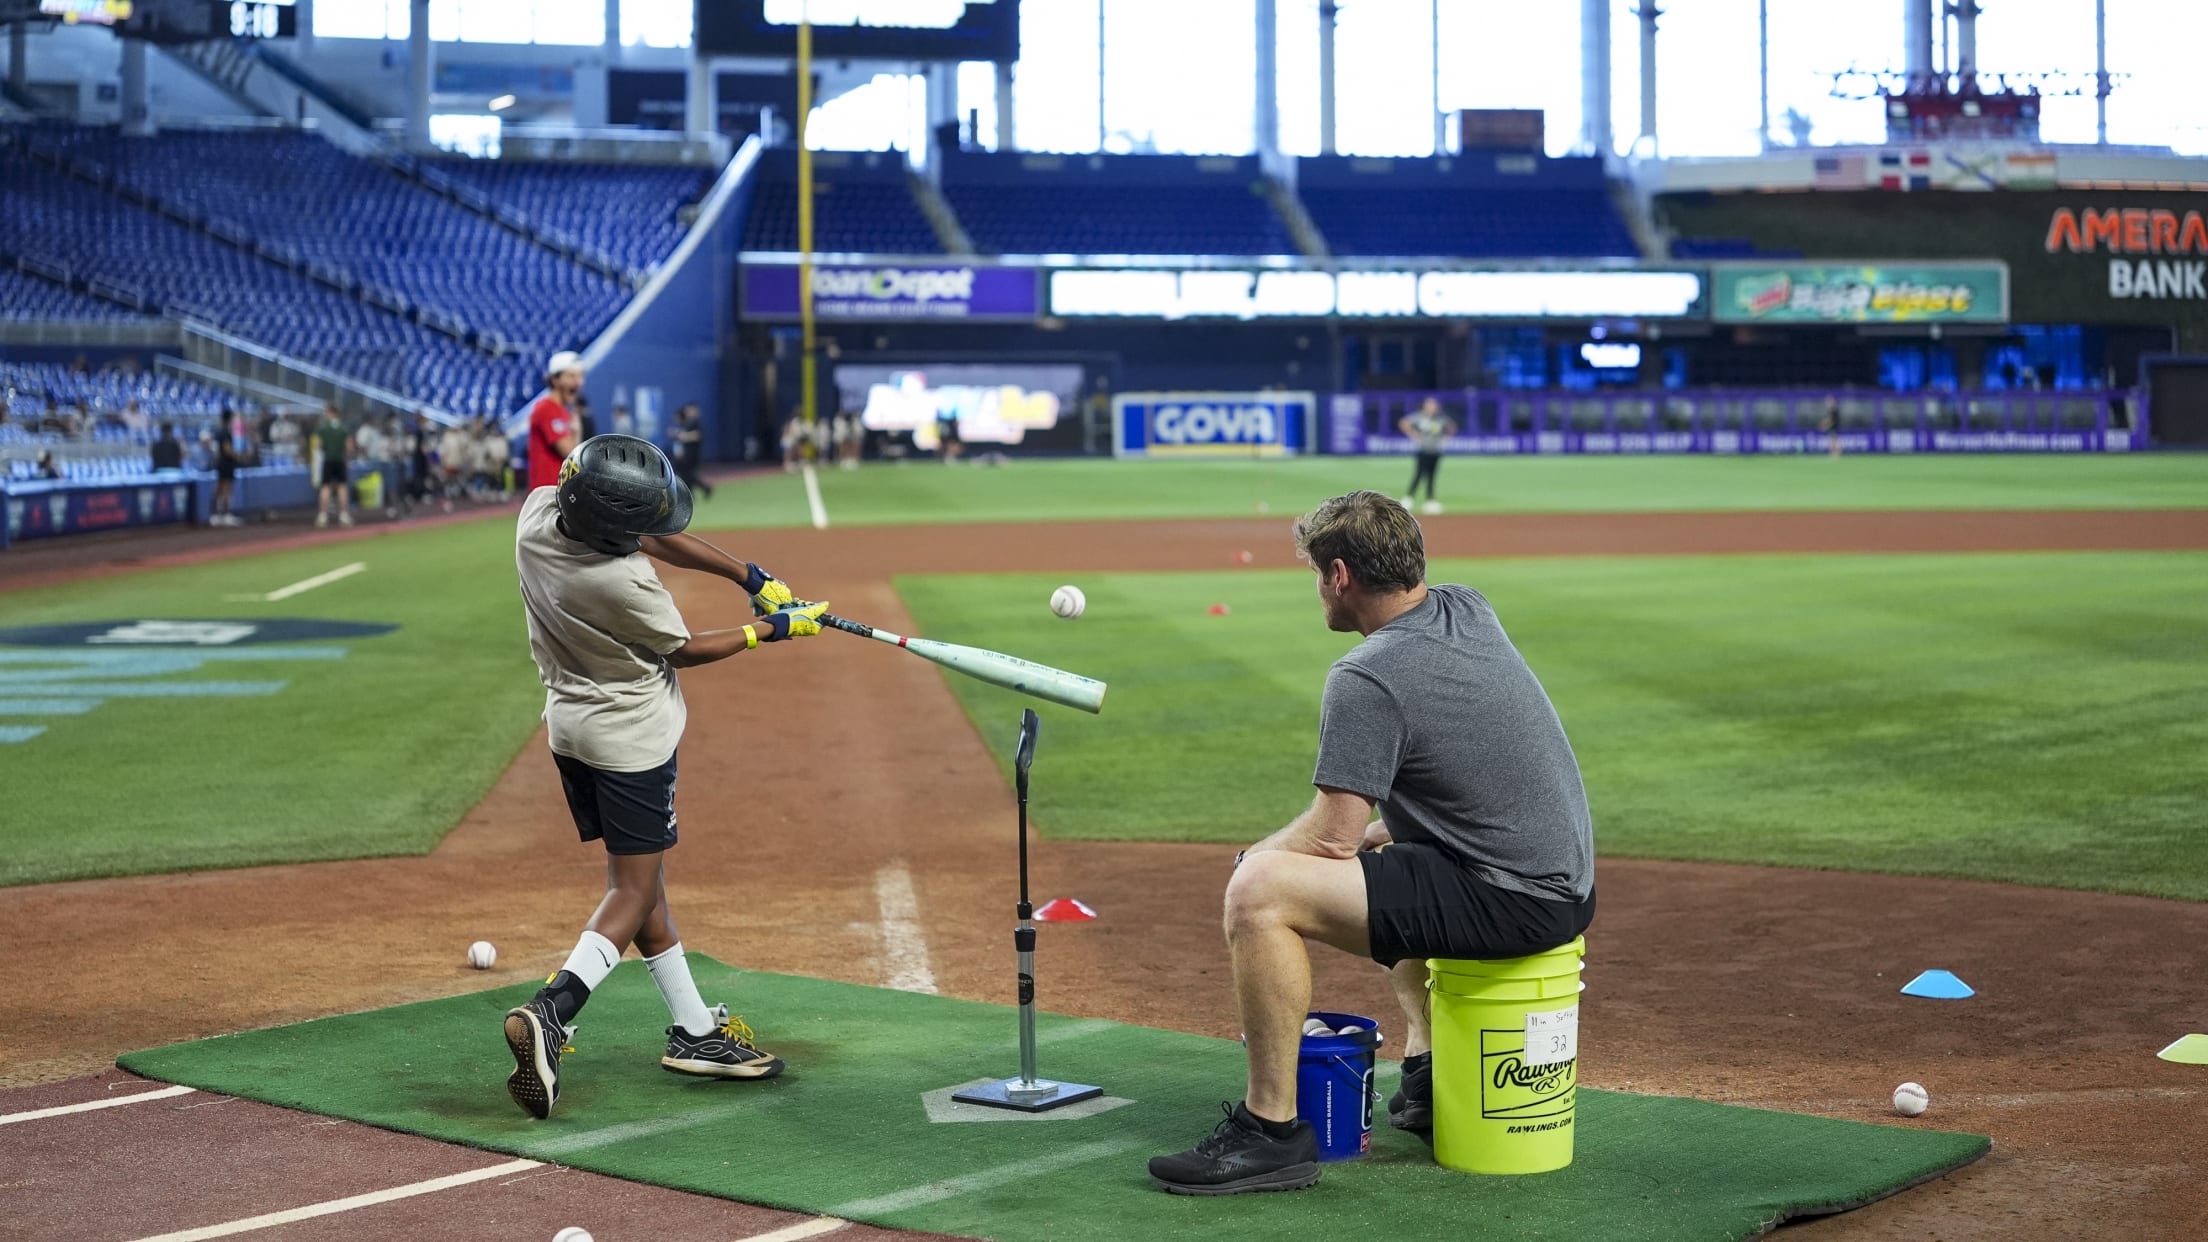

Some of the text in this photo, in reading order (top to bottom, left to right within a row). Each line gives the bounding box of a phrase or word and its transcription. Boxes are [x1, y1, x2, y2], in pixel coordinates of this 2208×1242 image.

[2109, 258, 2207, 299] BANK
[1154, 404, 1275, 443] GOYA
[1550, 1034, 1567, 1053] 32
[1507, 1117, 1573, 1134] RAWLINGS.COM
